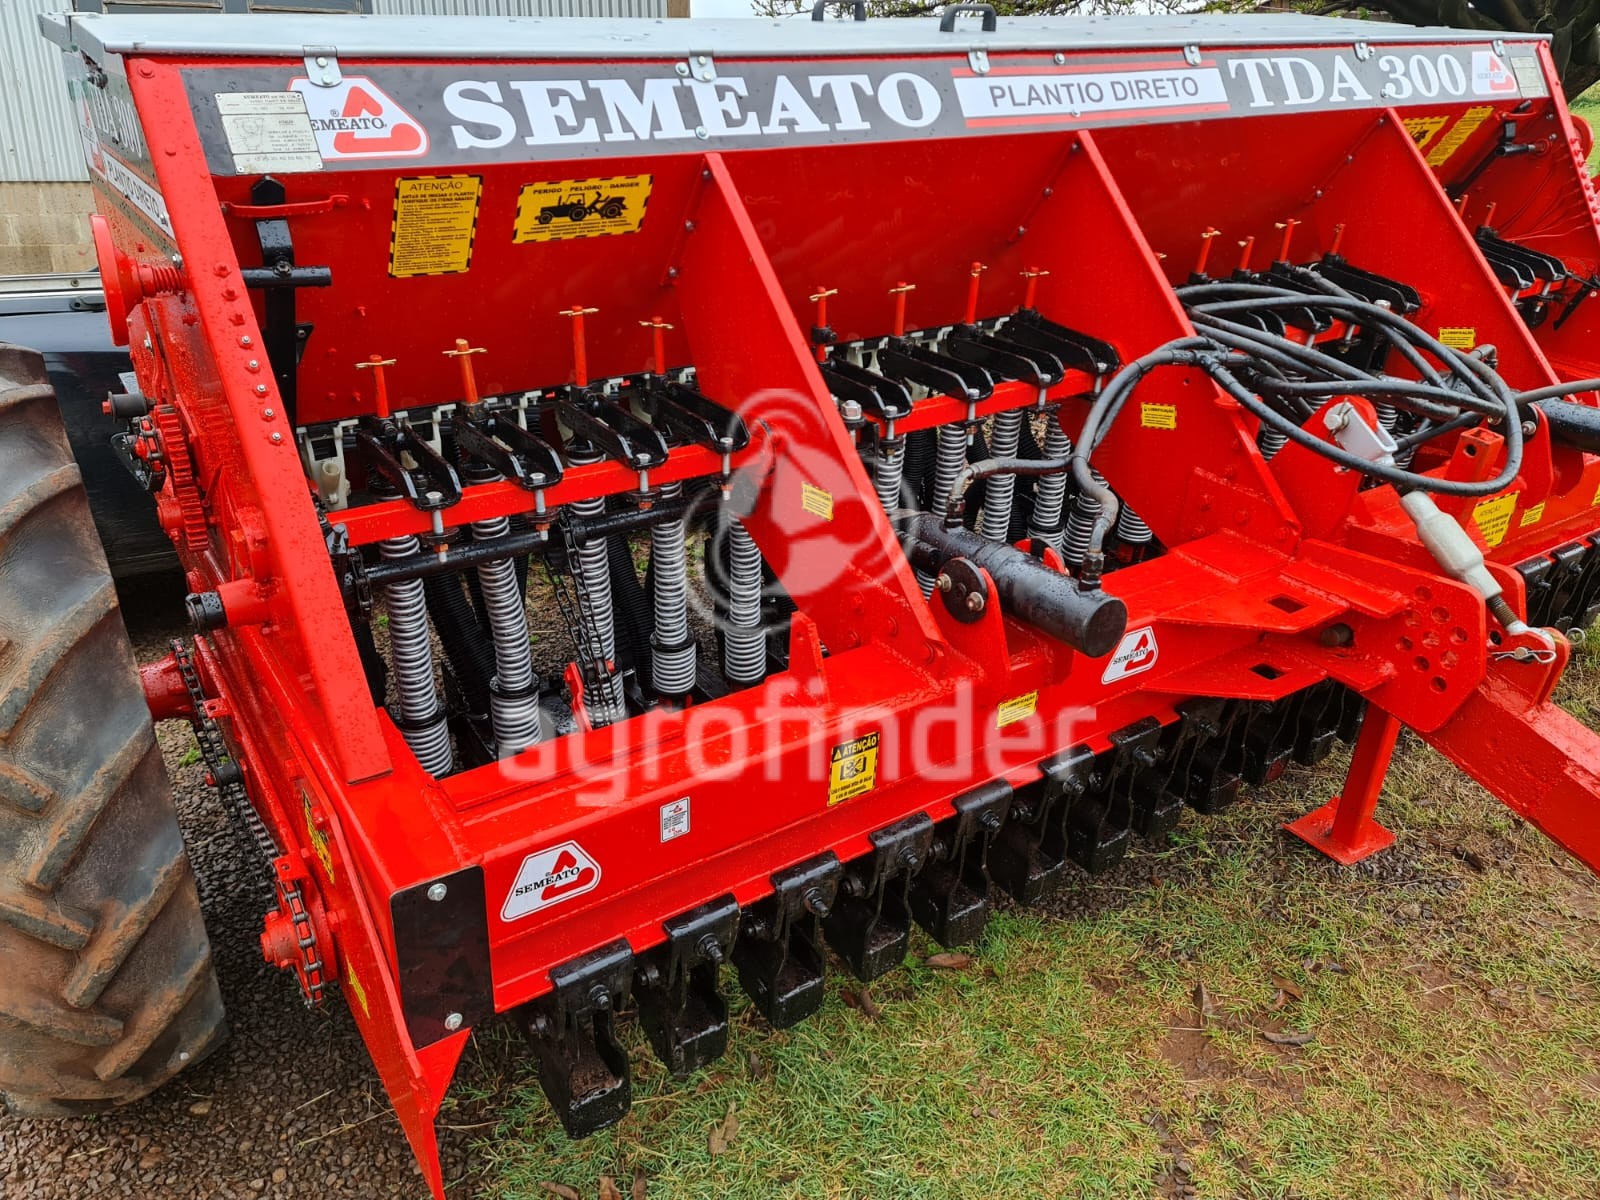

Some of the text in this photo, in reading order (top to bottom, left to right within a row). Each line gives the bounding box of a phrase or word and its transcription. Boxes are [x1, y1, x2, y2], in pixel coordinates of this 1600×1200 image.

[989, 76, 1199, 107] PLANTIO DIRETO
[1227, 54, 1373, 107] TDA
[1378, 53, 1467, 99] 300
[443, 72, 942, 149] SEMEATO
[410, 181, 463, 192] ATENÇÃO
[1112, 648, 1149, 665] SEMEATO
[842, 735, 877, 756] ATENÇÃO
[515, 866, 581, 897] SEMEATO
